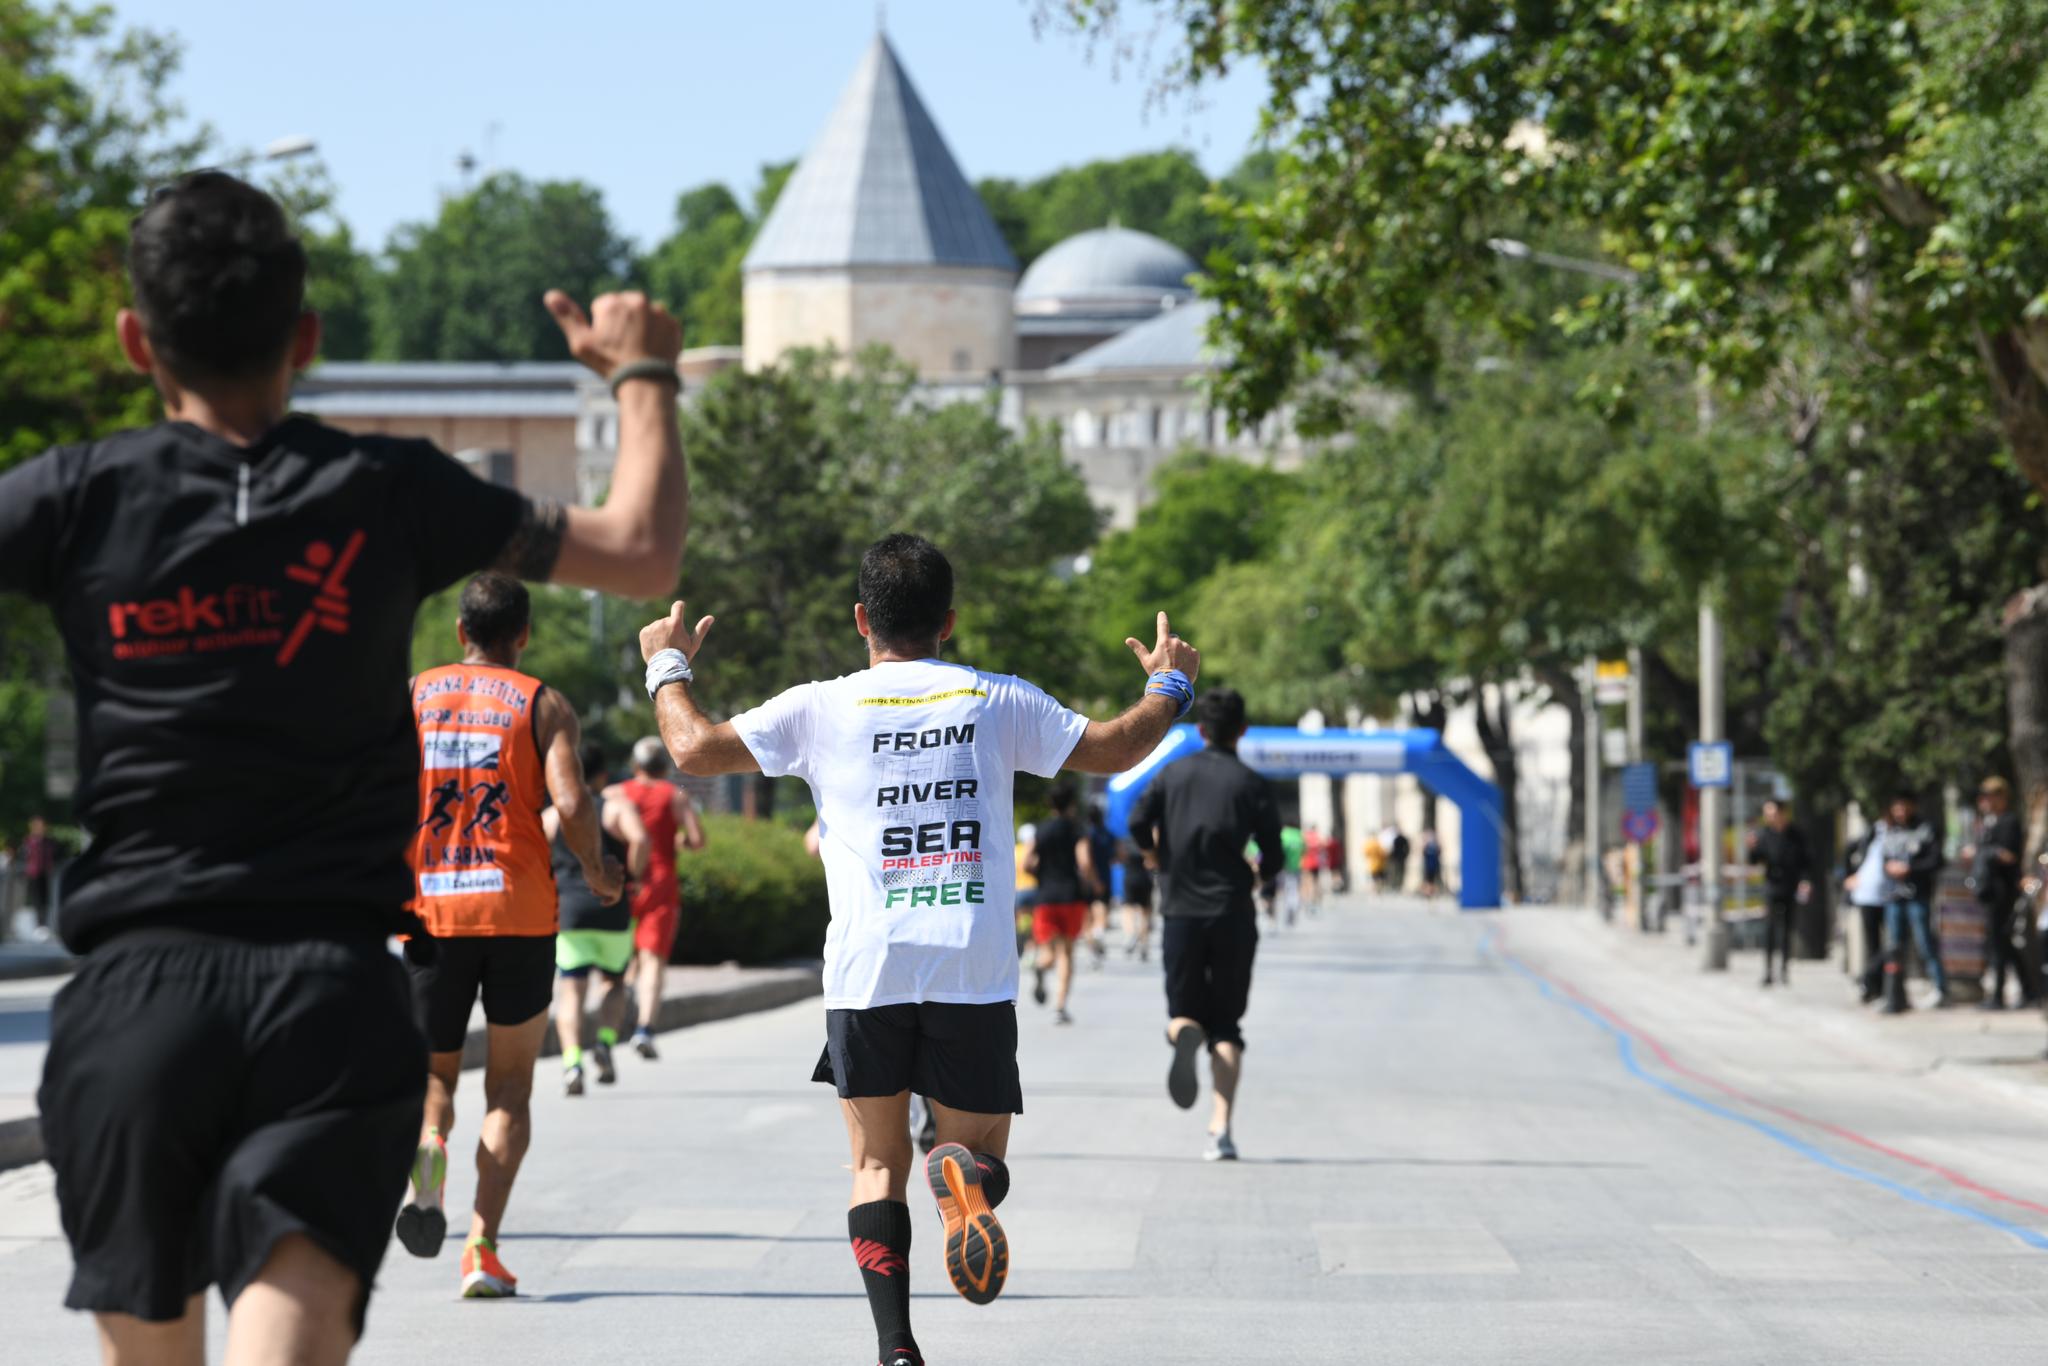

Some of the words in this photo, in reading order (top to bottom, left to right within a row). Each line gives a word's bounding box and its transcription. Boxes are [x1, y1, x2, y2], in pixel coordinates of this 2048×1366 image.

[873, 724, 975, 753] FROM
[877, 779, 978, 807] RIVER
[881, 820, 981, 857] SEA
[882, 851, 982, 870] PALESTINE
[885, 881, 985, 909] FREE
